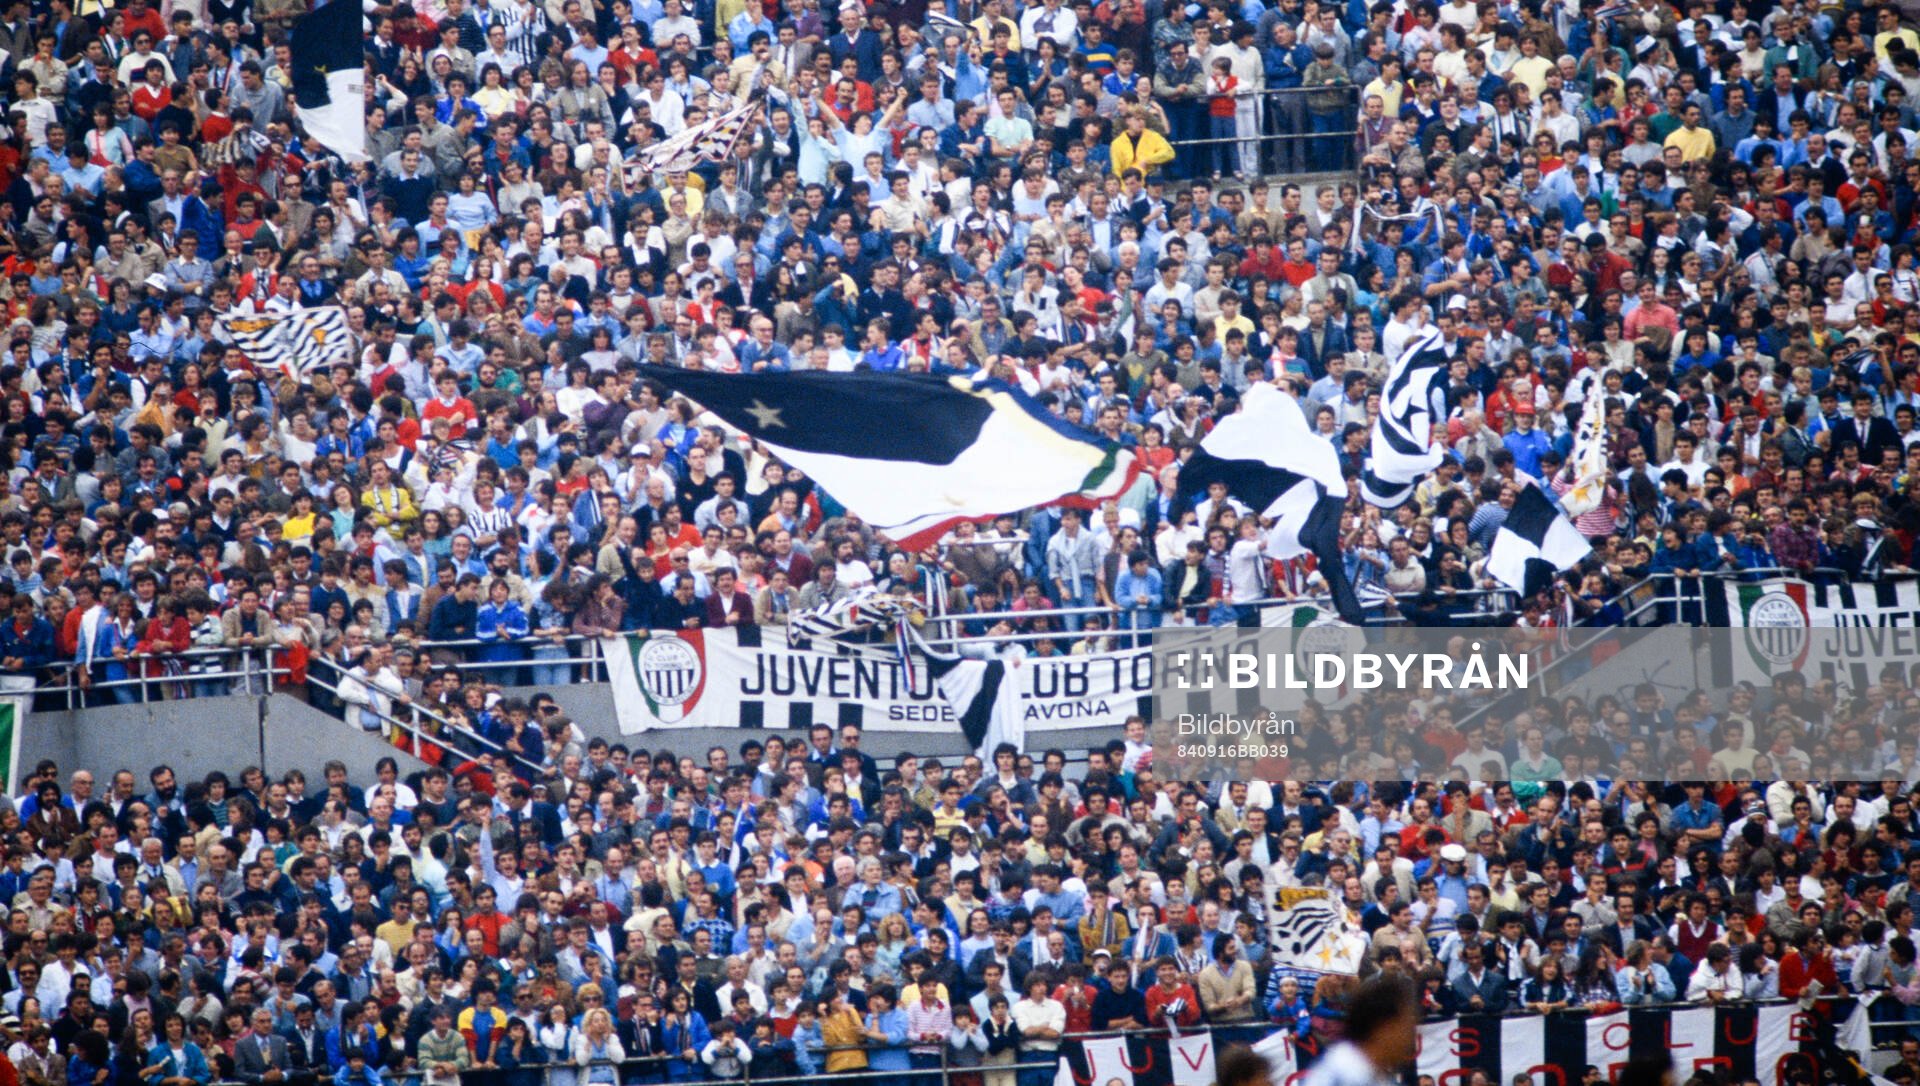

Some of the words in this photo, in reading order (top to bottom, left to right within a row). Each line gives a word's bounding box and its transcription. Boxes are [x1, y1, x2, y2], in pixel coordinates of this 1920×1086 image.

[741, 653, 946, 700] JUVENTU
[889, 705, 955, 722] SEDE
[1024, 700, 1110, 721] AVONA
